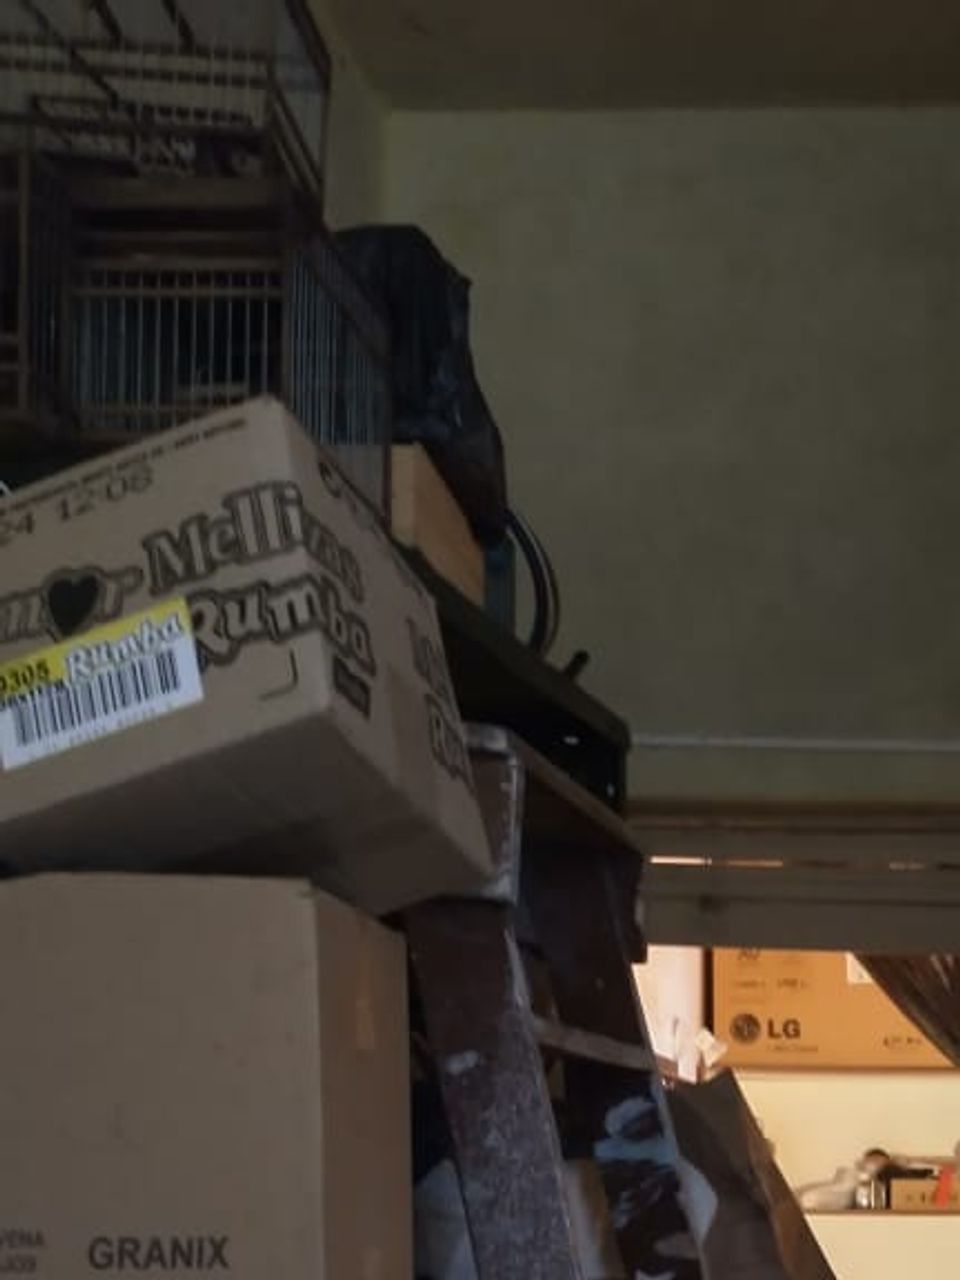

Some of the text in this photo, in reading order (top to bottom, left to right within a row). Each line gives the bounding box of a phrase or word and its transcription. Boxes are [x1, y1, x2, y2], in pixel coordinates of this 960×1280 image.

[65, 611, 183, 682] Rumba
[767, 1018, 801, 1039] LG
[88, 1235, 229, 1270] GRANIX
